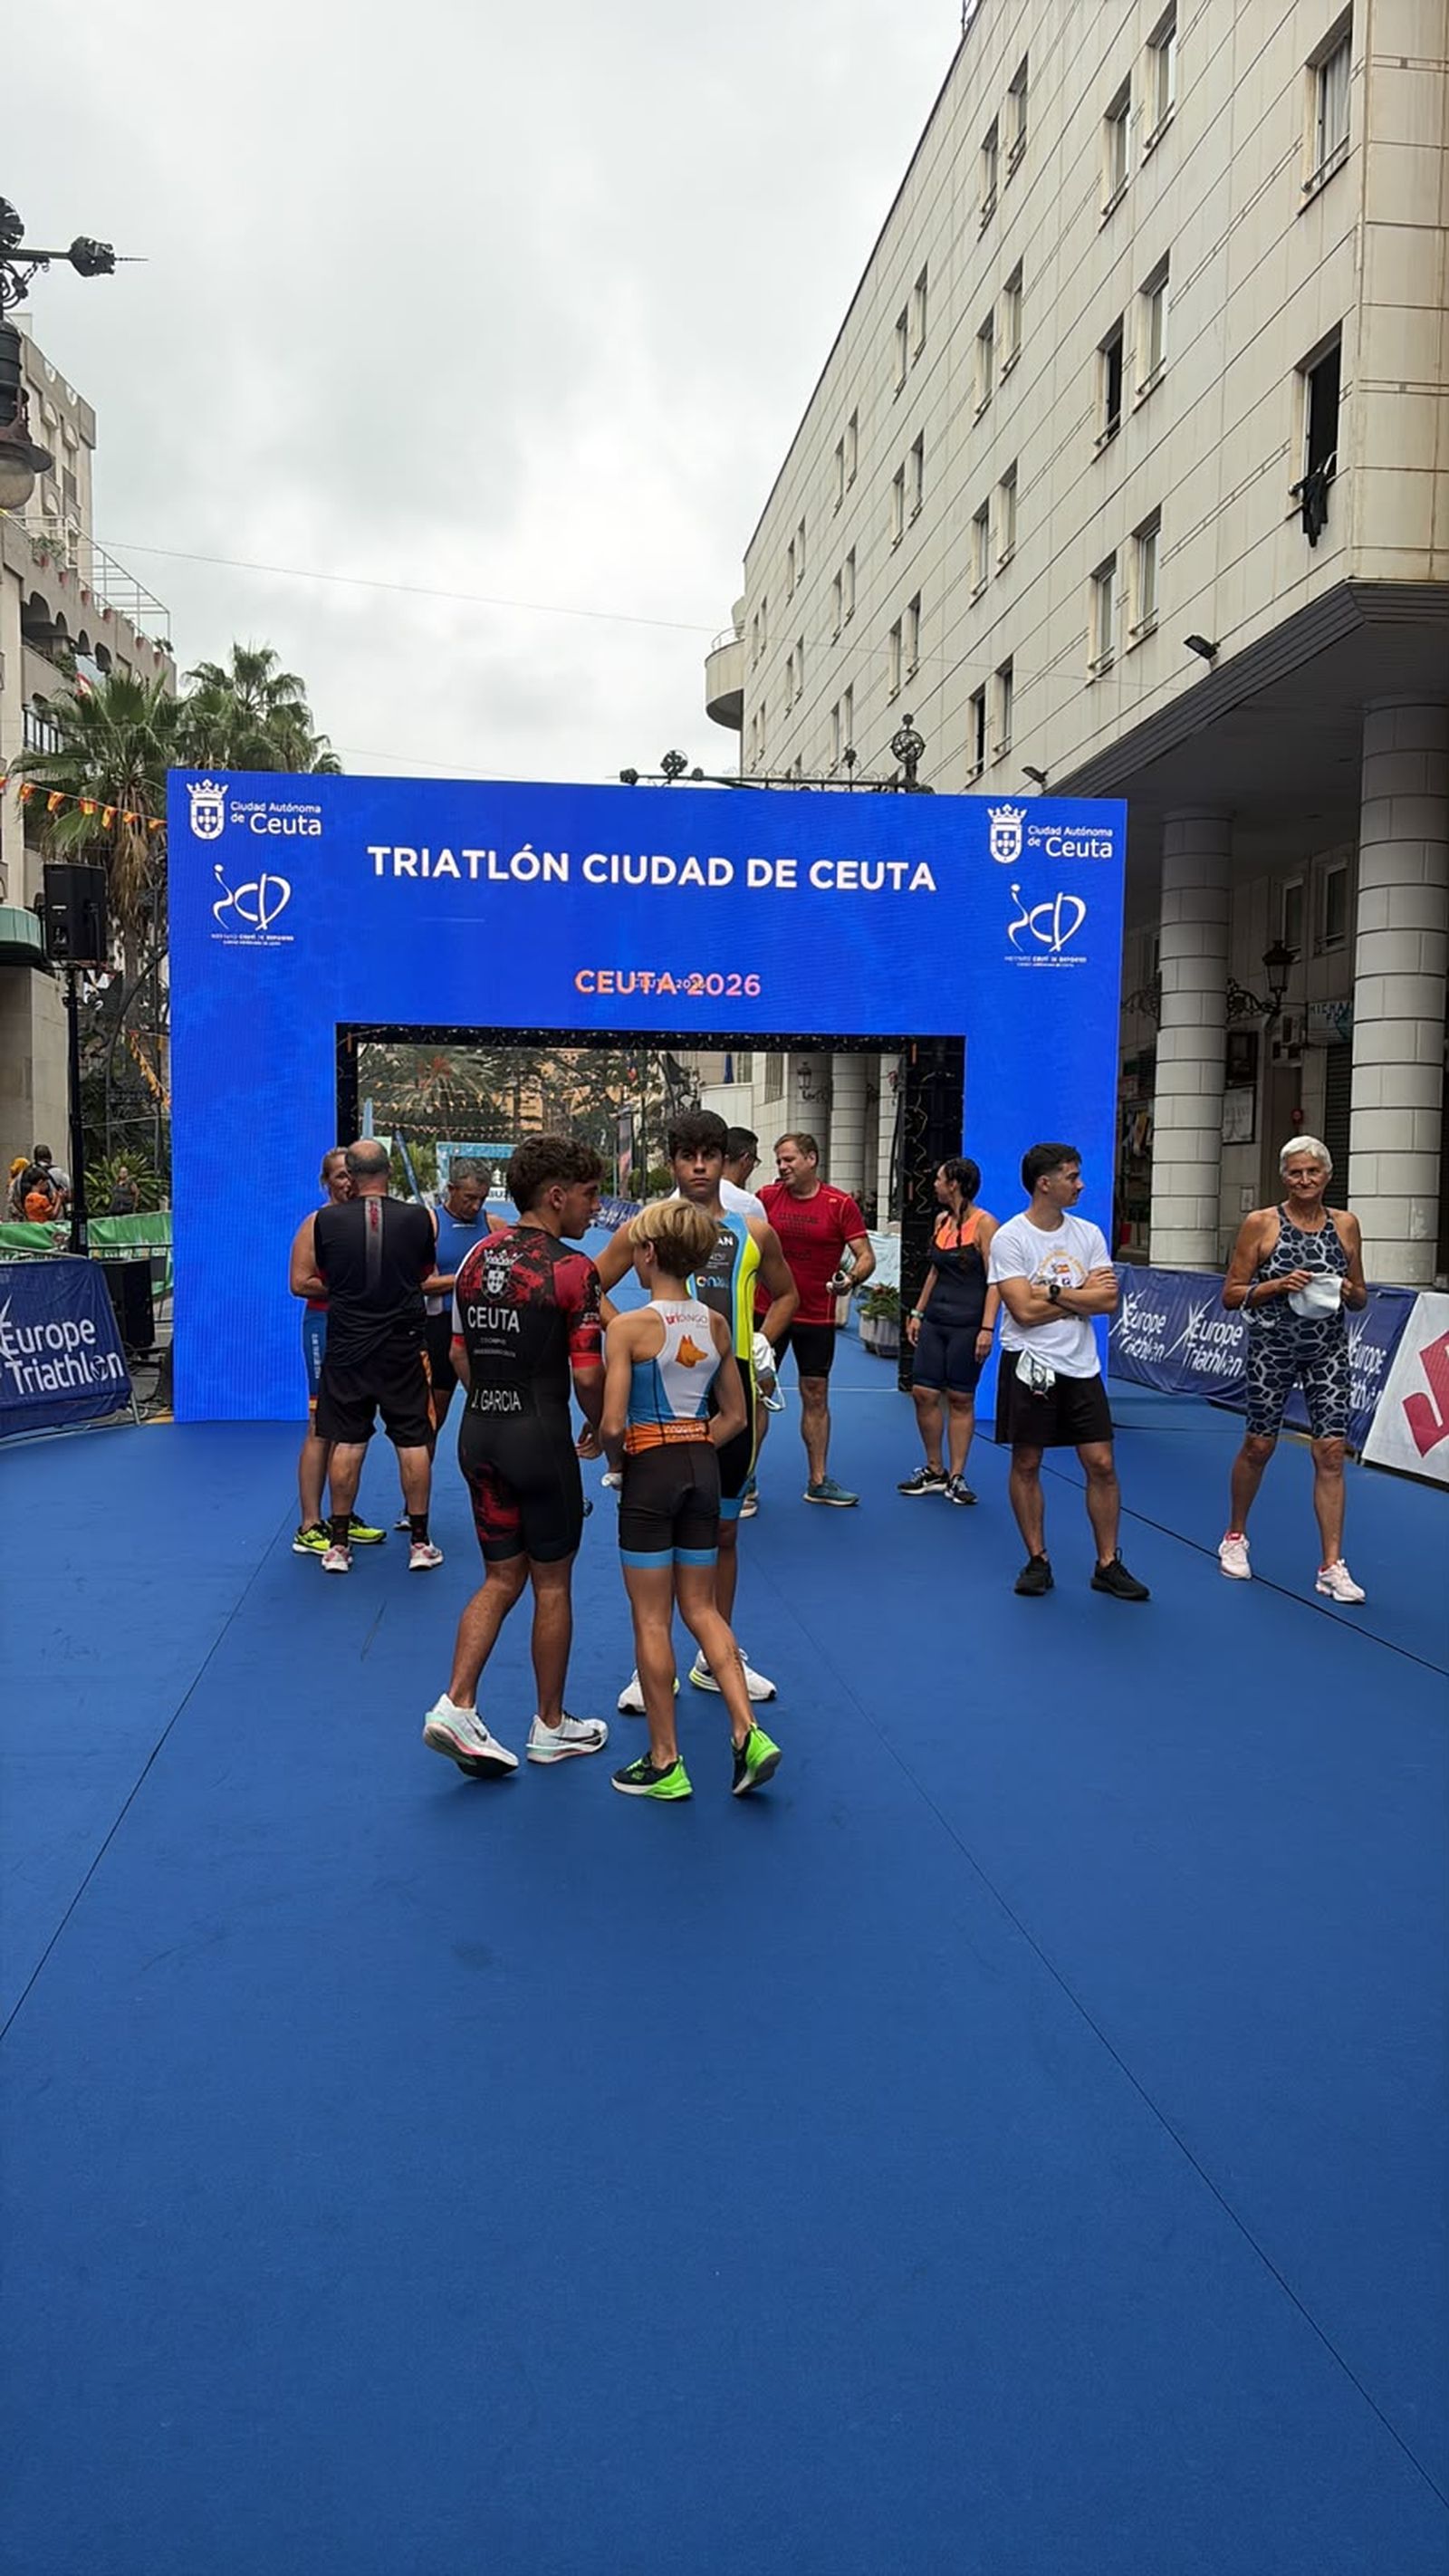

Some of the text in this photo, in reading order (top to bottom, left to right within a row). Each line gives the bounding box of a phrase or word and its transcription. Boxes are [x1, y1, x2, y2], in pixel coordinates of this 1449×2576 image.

[230, 801, 321, 813] Ciudad Autónoma
[230, 812, 321, 835] de Ceuta
[1028, 825, 1113, 837] Ciudad Autónoma
[1028, 837, 1113, 859] de Ceuta
[367, 843, 936, 891] TRIATLÓN CIUDAD DE CEUTA
[575, 969, 761, 996] CEUTA 2026
[467, 1305, 521, 1333] CEUTA
[1124, 1303, 1166, 1335] Europe
[1191, 1312, 1243, 1346] Europe
[0, 1319, 96, 1355] Europe
[1183, 1342, 1243, 1377] Triathlon
[1349, 1337, 1387, 1375] Europe
[5, 1350, 124, 1394] Triathlon
[481, 1389, 522, 1411] GARCIA
